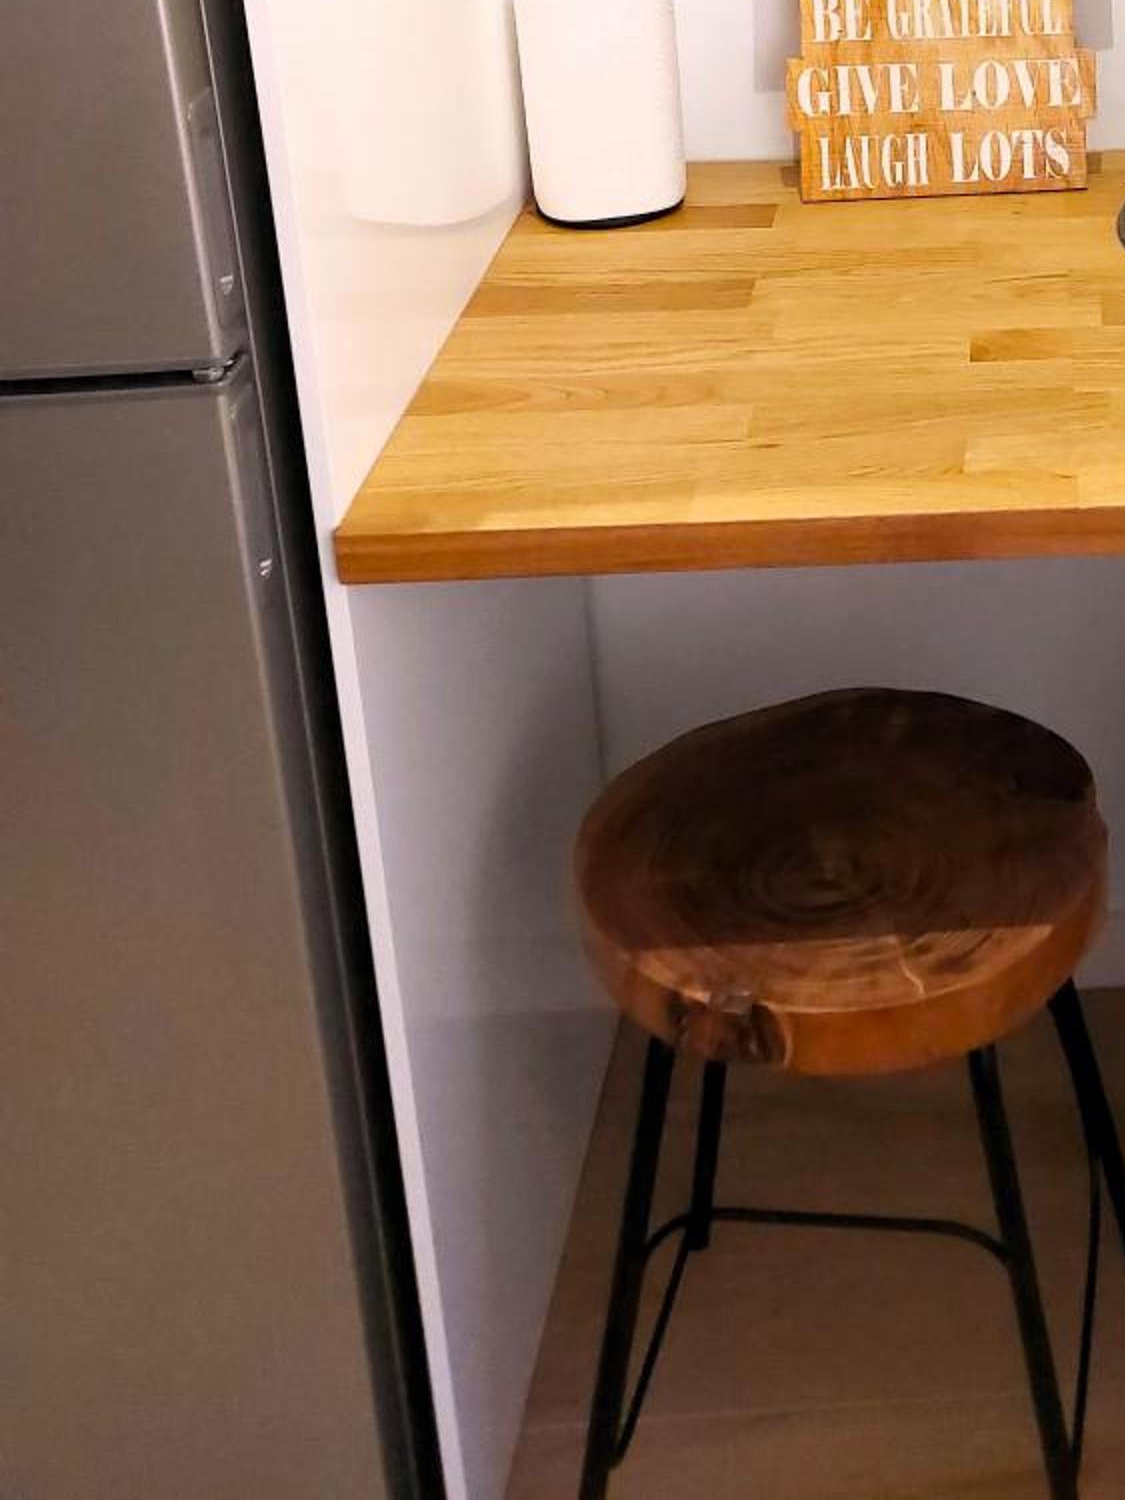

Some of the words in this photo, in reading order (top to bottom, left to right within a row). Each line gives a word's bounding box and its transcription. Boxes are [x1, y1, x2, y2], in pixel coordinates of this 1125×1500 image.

[797, 63, 920, 117] GIVE
[939, 58, 1081, 112] LOVE
[820, 133, 929, 191] LAUGH
[951, 129, 1071, 183] LOTS
